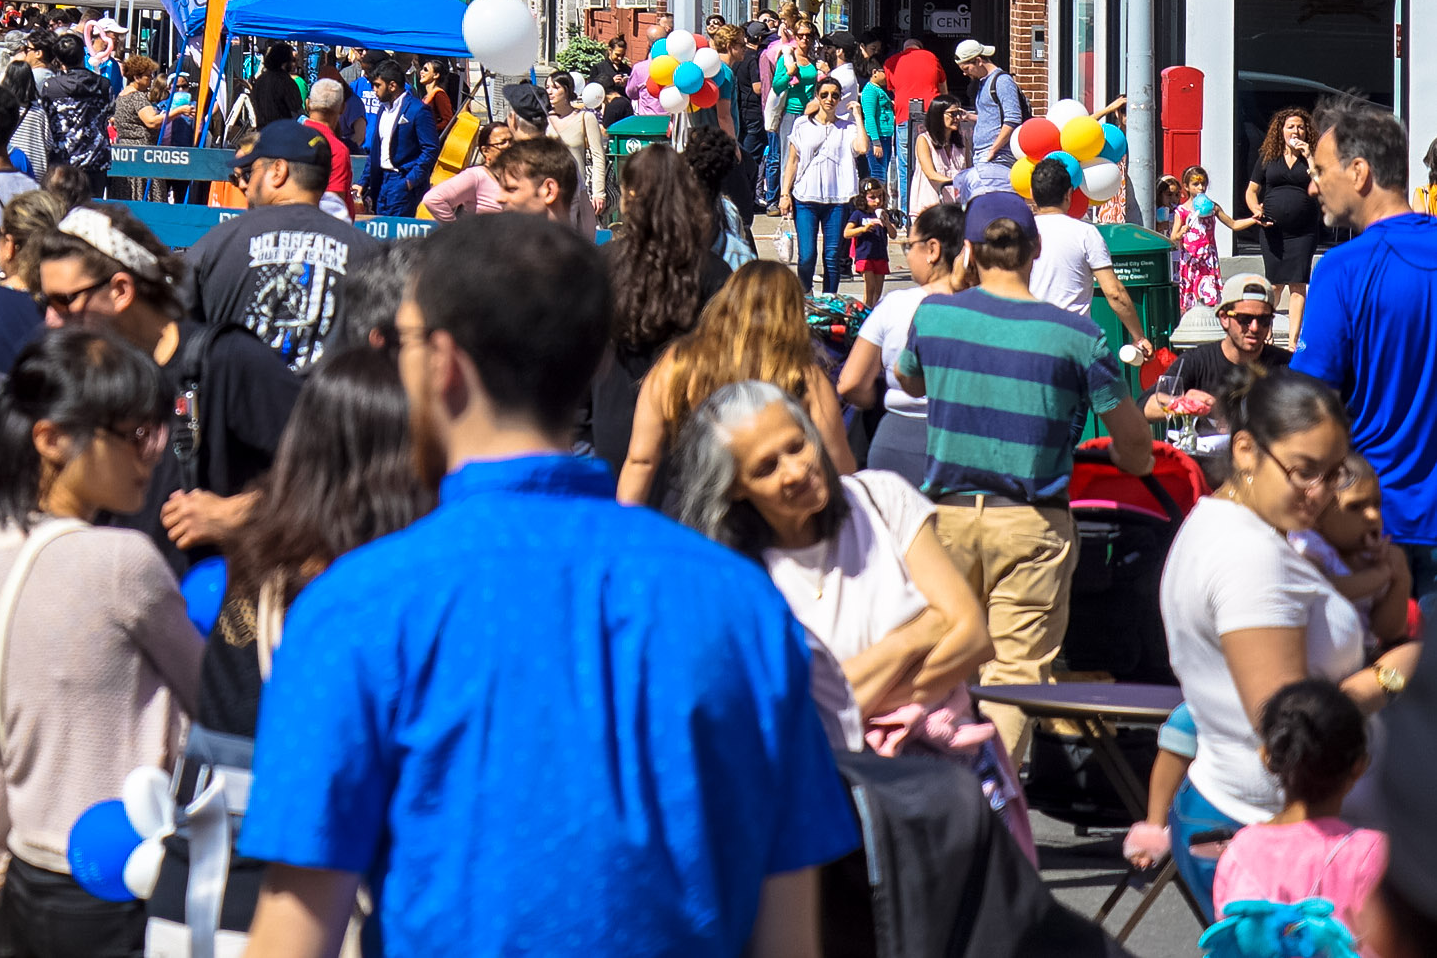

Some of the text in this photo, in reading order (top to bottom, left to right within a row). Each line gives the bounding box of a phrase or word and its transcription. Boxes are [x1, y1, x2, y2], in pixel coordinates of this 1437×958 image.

[936, 17, 970, 28] CENT
[110, 147, 190, 164] NOT CROSS
[396, 222, 432, 240] NOT
[279, 231, 348, 261] BREACH
[257, 249, 279, 261] OUT
